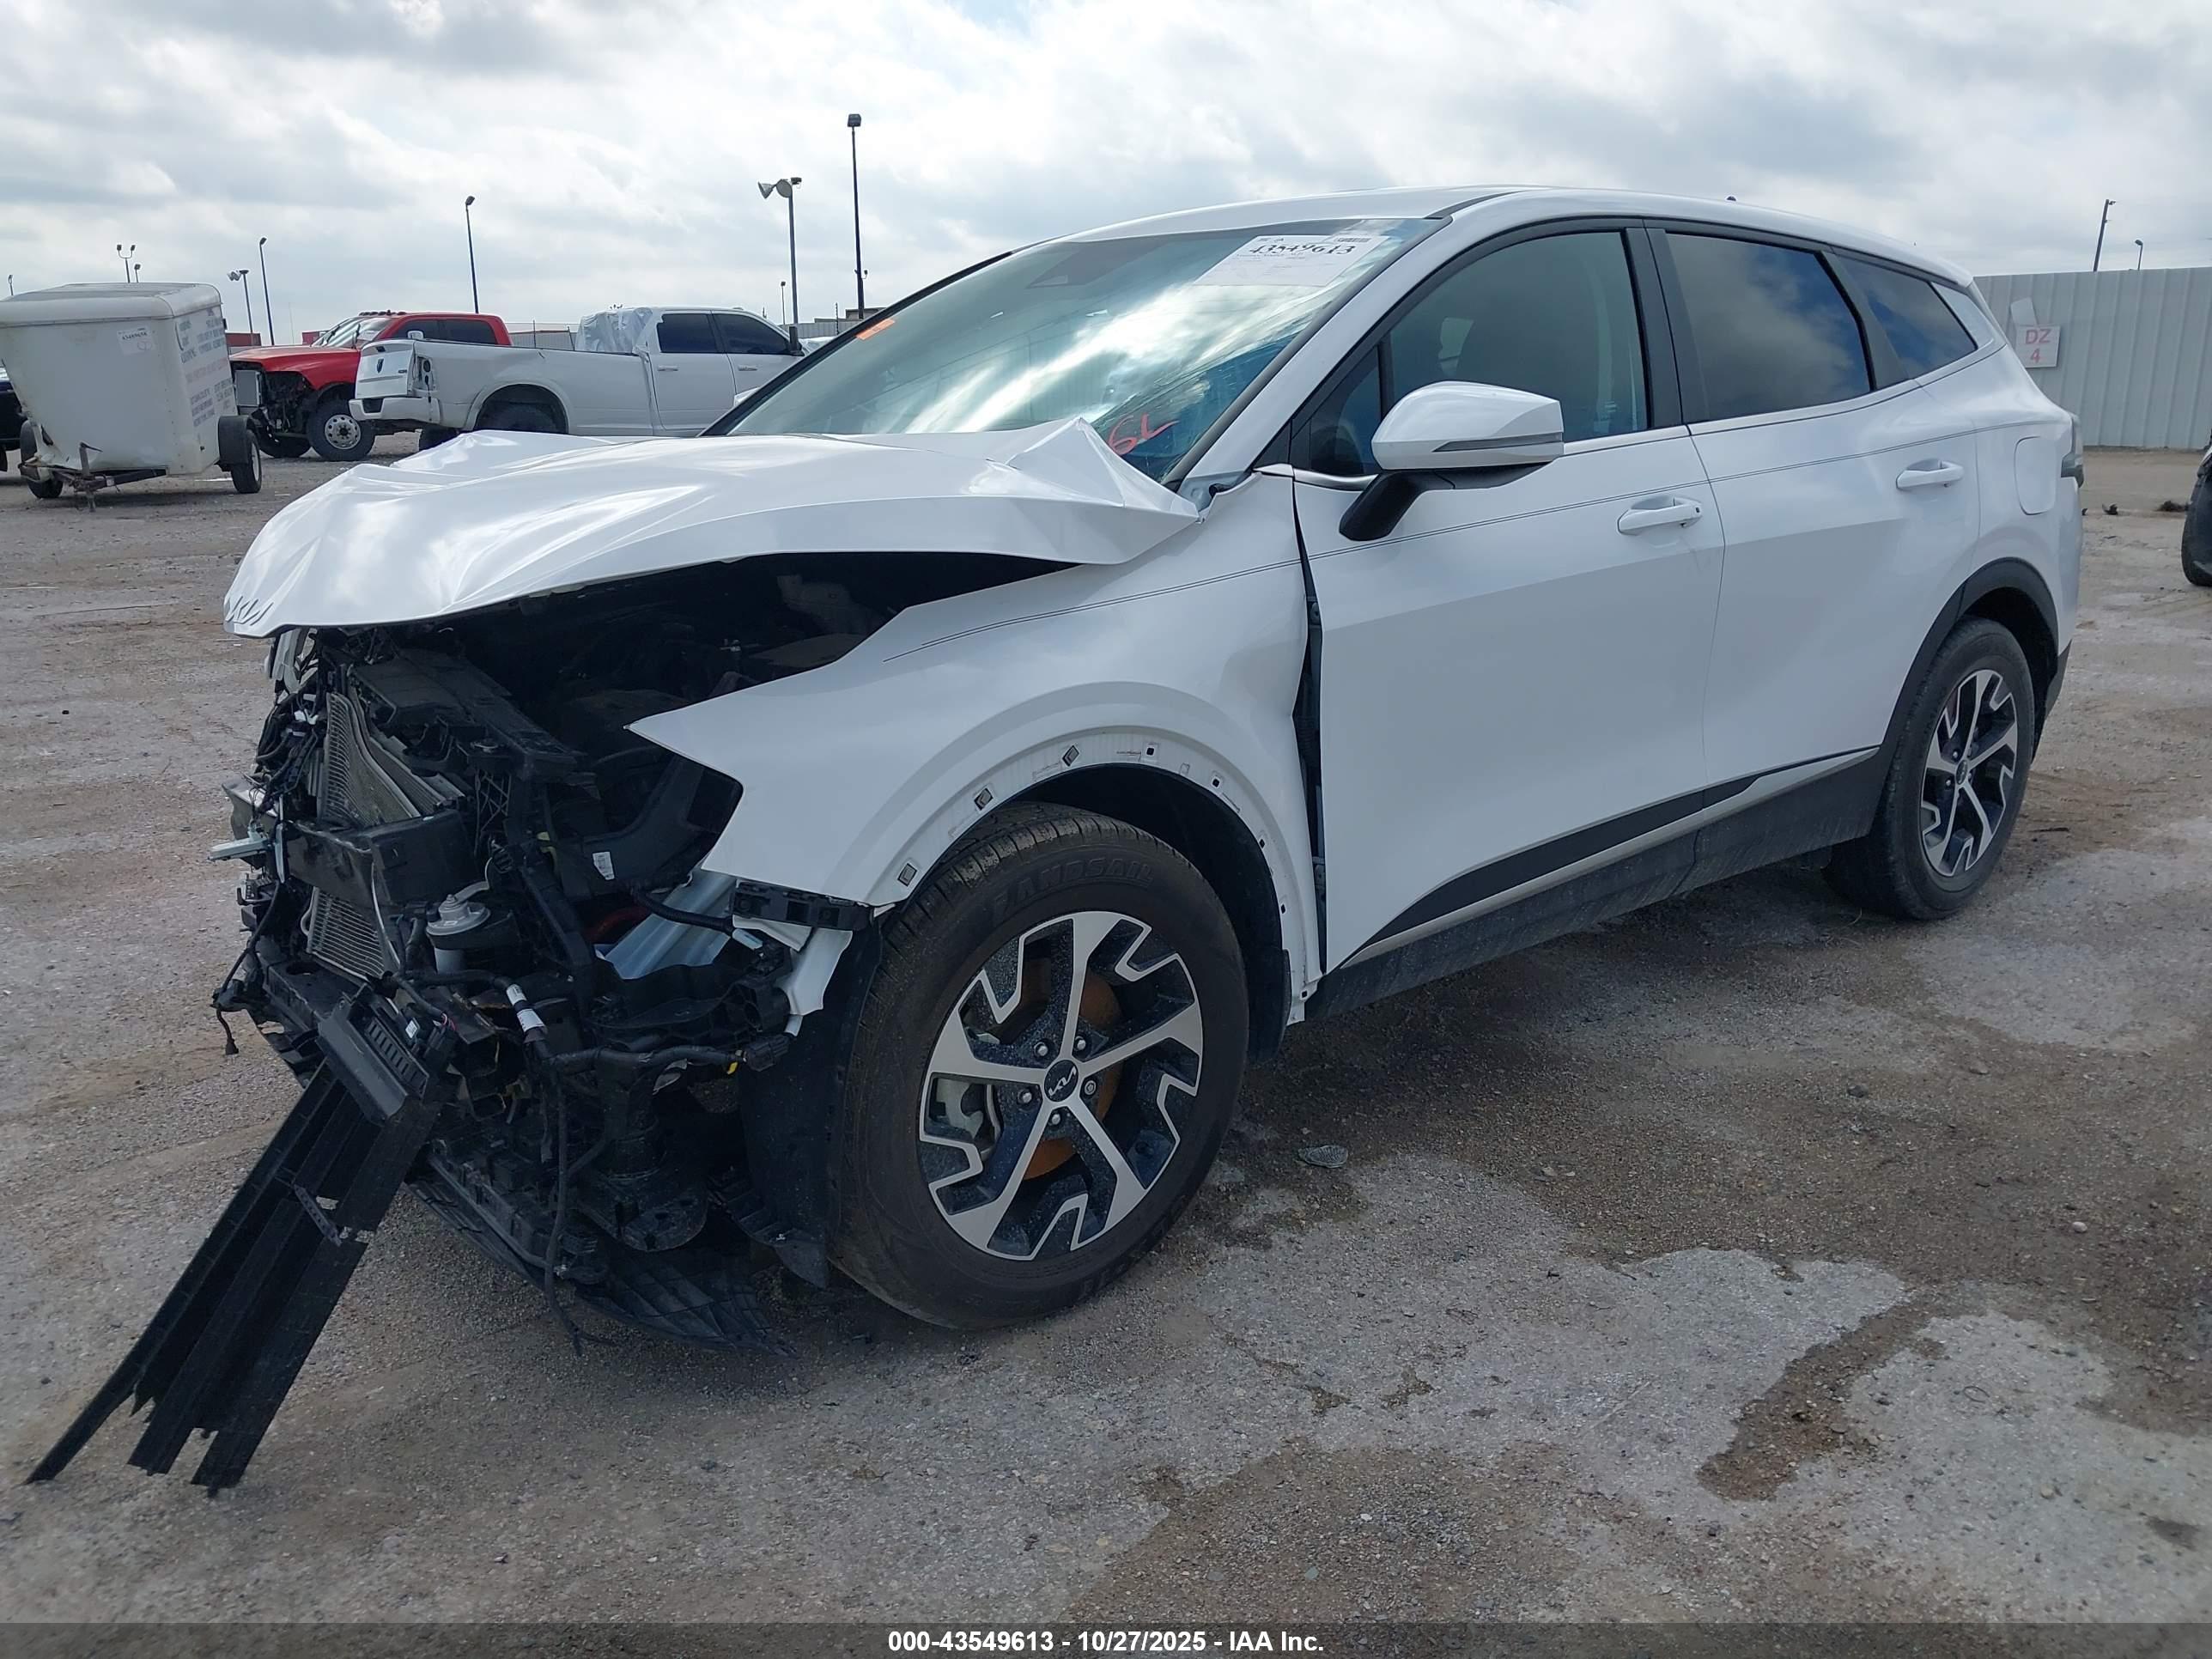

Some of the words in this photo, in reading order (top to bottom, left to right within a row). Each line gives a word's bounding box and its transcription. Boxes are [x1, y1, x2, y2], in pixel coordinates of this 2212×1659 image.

[1249, 243, 1357, 256] 43549613
[2026, 329, 2051, 344] DZ
[2030, 348, 2040, 363] 4
